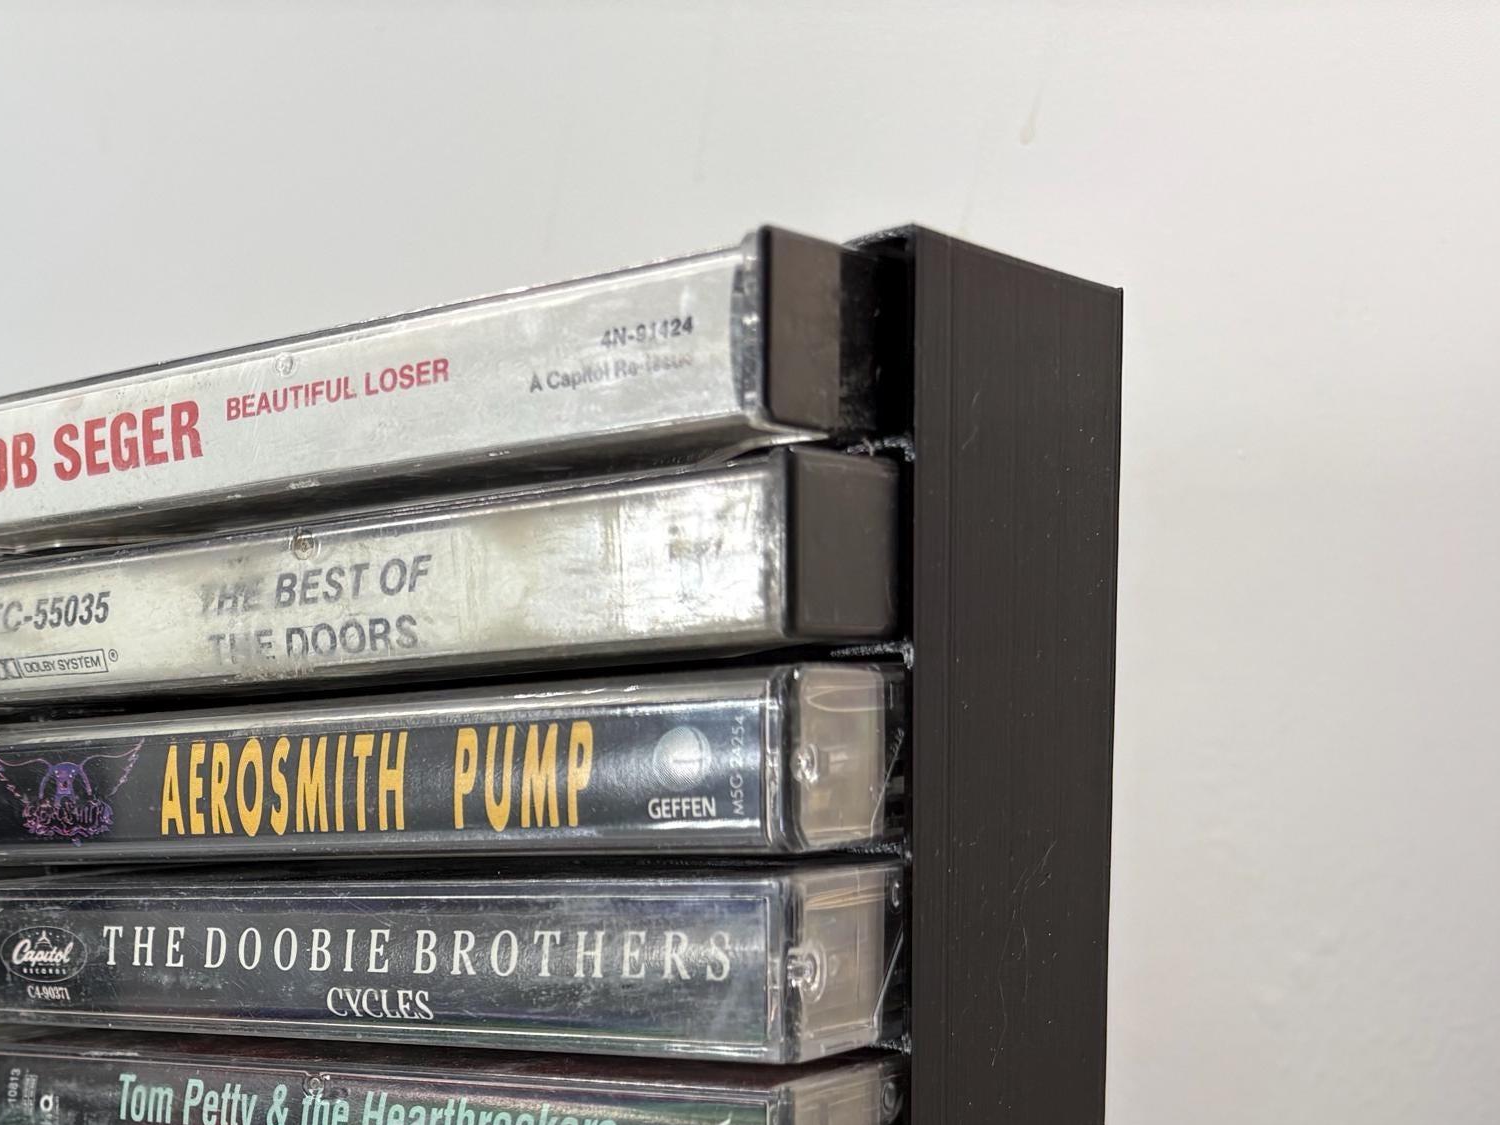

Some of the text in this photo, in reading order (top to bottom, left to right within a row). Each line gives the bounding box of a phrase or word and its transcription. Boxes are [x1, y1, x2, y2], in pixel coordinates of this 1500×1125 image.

[226, 358, 450, 421] BEAUTIFUL LOSER
[530, 372, 543, 393] A
[546, 361, 610, 390] Capitol
[53, 401, 204, 483] SEGER
[275, 562, 370, 609] BEST
[379, 553, 432, 596] OF
[286, 614, 418, 658] DOORS
[24, 655, 101, 674] DOLBY SYSTEM
[161, 721, 593, 836] AEROSMITH PUMP
[648, 797, 717, 819] GEFFEN
[11, 938, 74, 967] Capitol
[103, 926, 731, 982] THE DOOBIE BROTHERS
[26, 985, 71, 1001] C4-90371
[326, 986, 434, 1020] CYCLES
[118, 1074, 174, 1125] Tom
